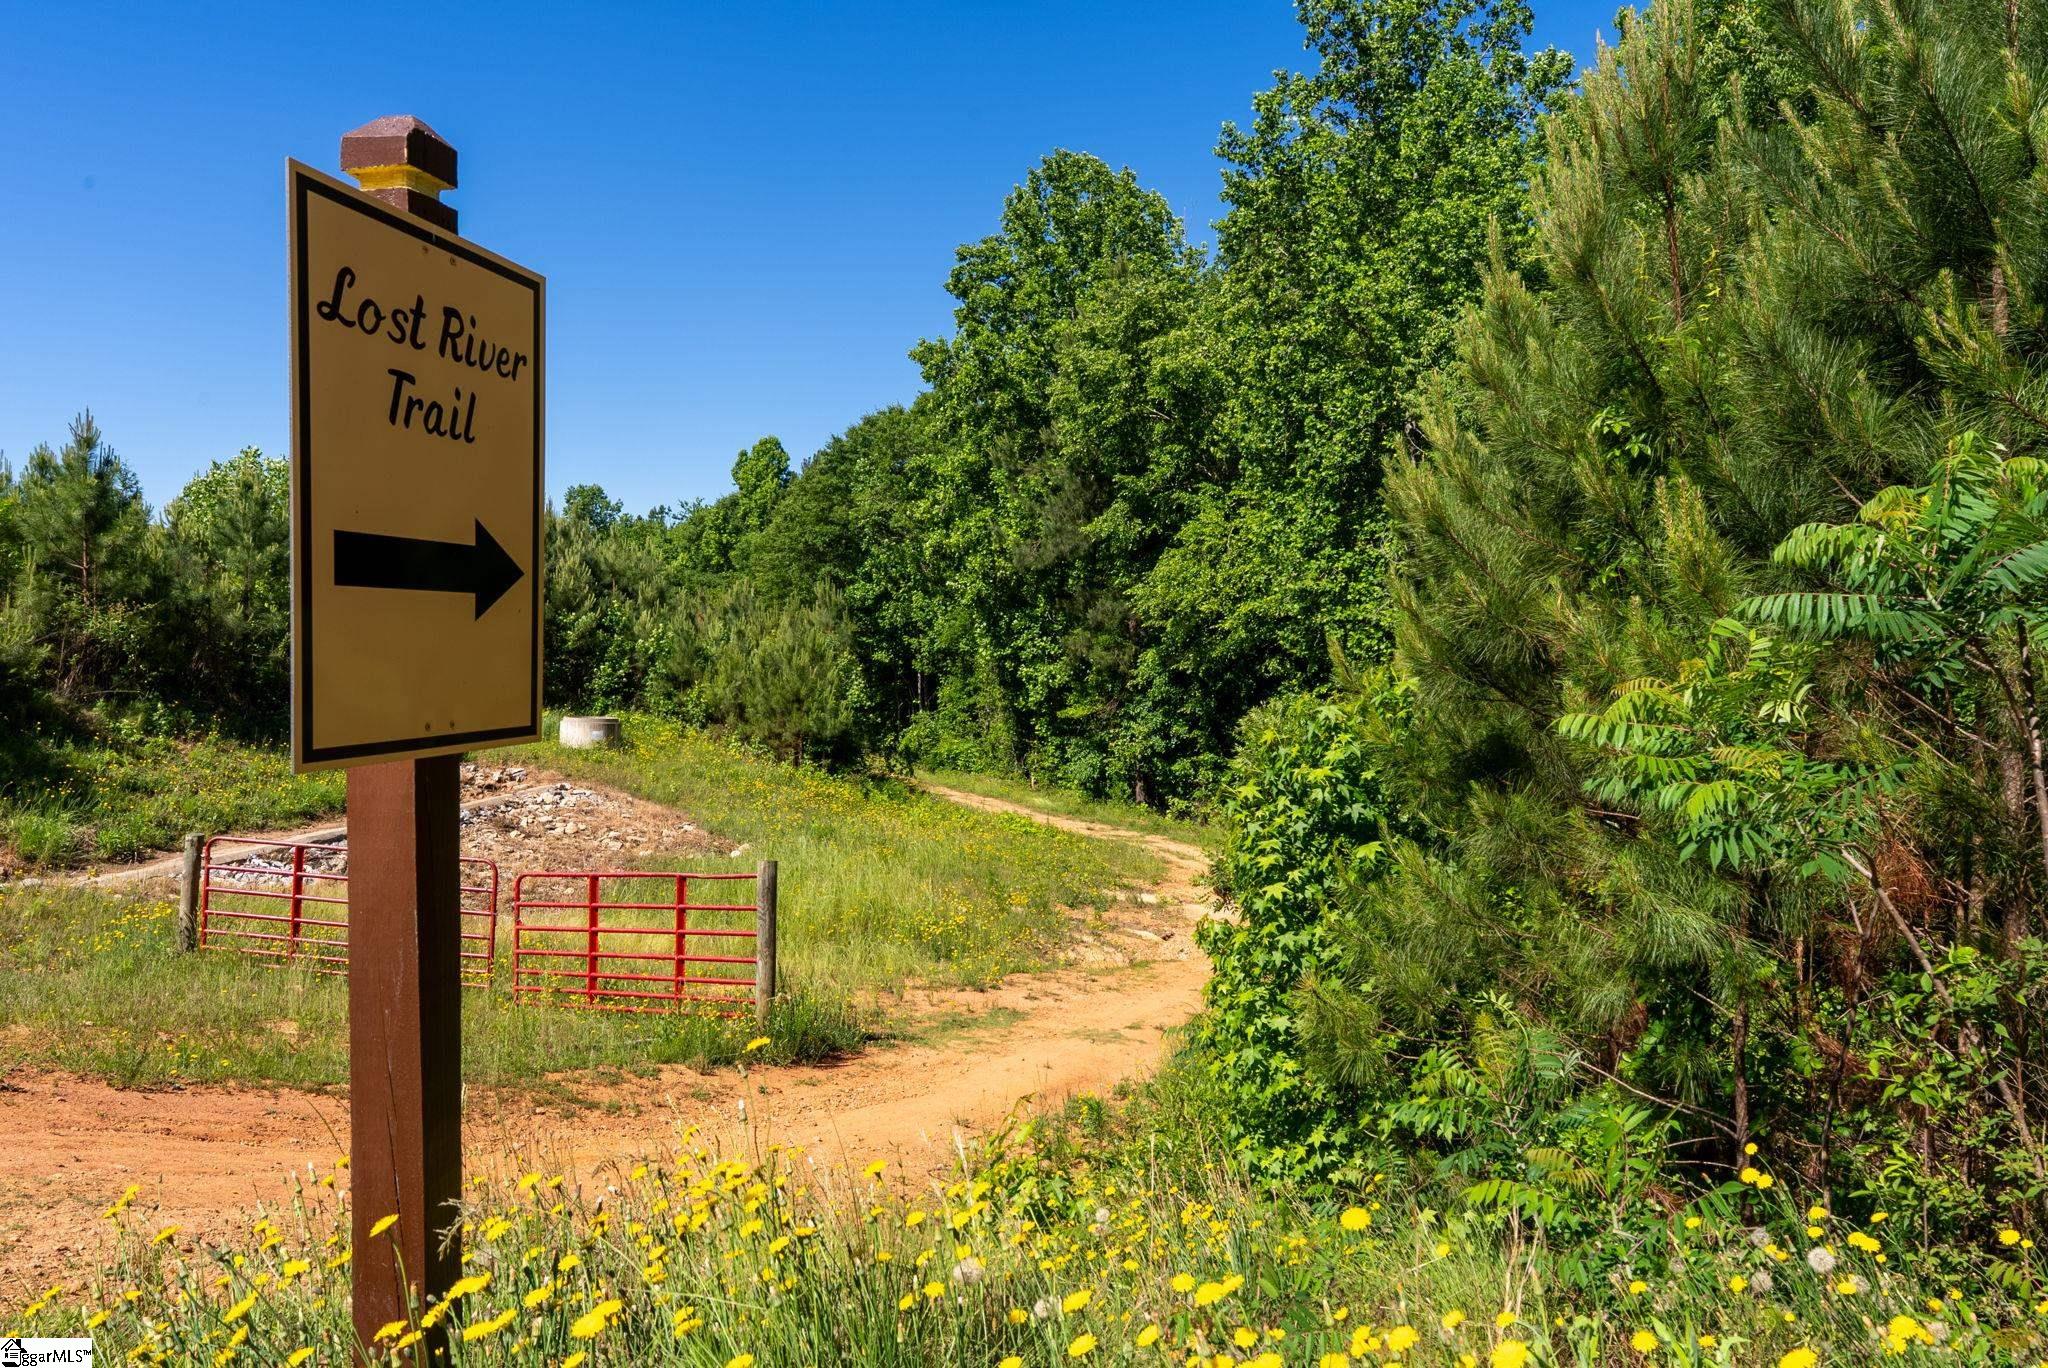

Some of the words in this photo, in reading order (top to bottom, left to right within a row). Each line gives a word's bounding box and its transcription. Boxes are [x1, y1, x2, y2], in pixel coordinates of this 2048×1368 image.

[316, 266, 427, 350] Lost
[438, 306, 528, 382] River
[387, 368, 477, 444] Trail
